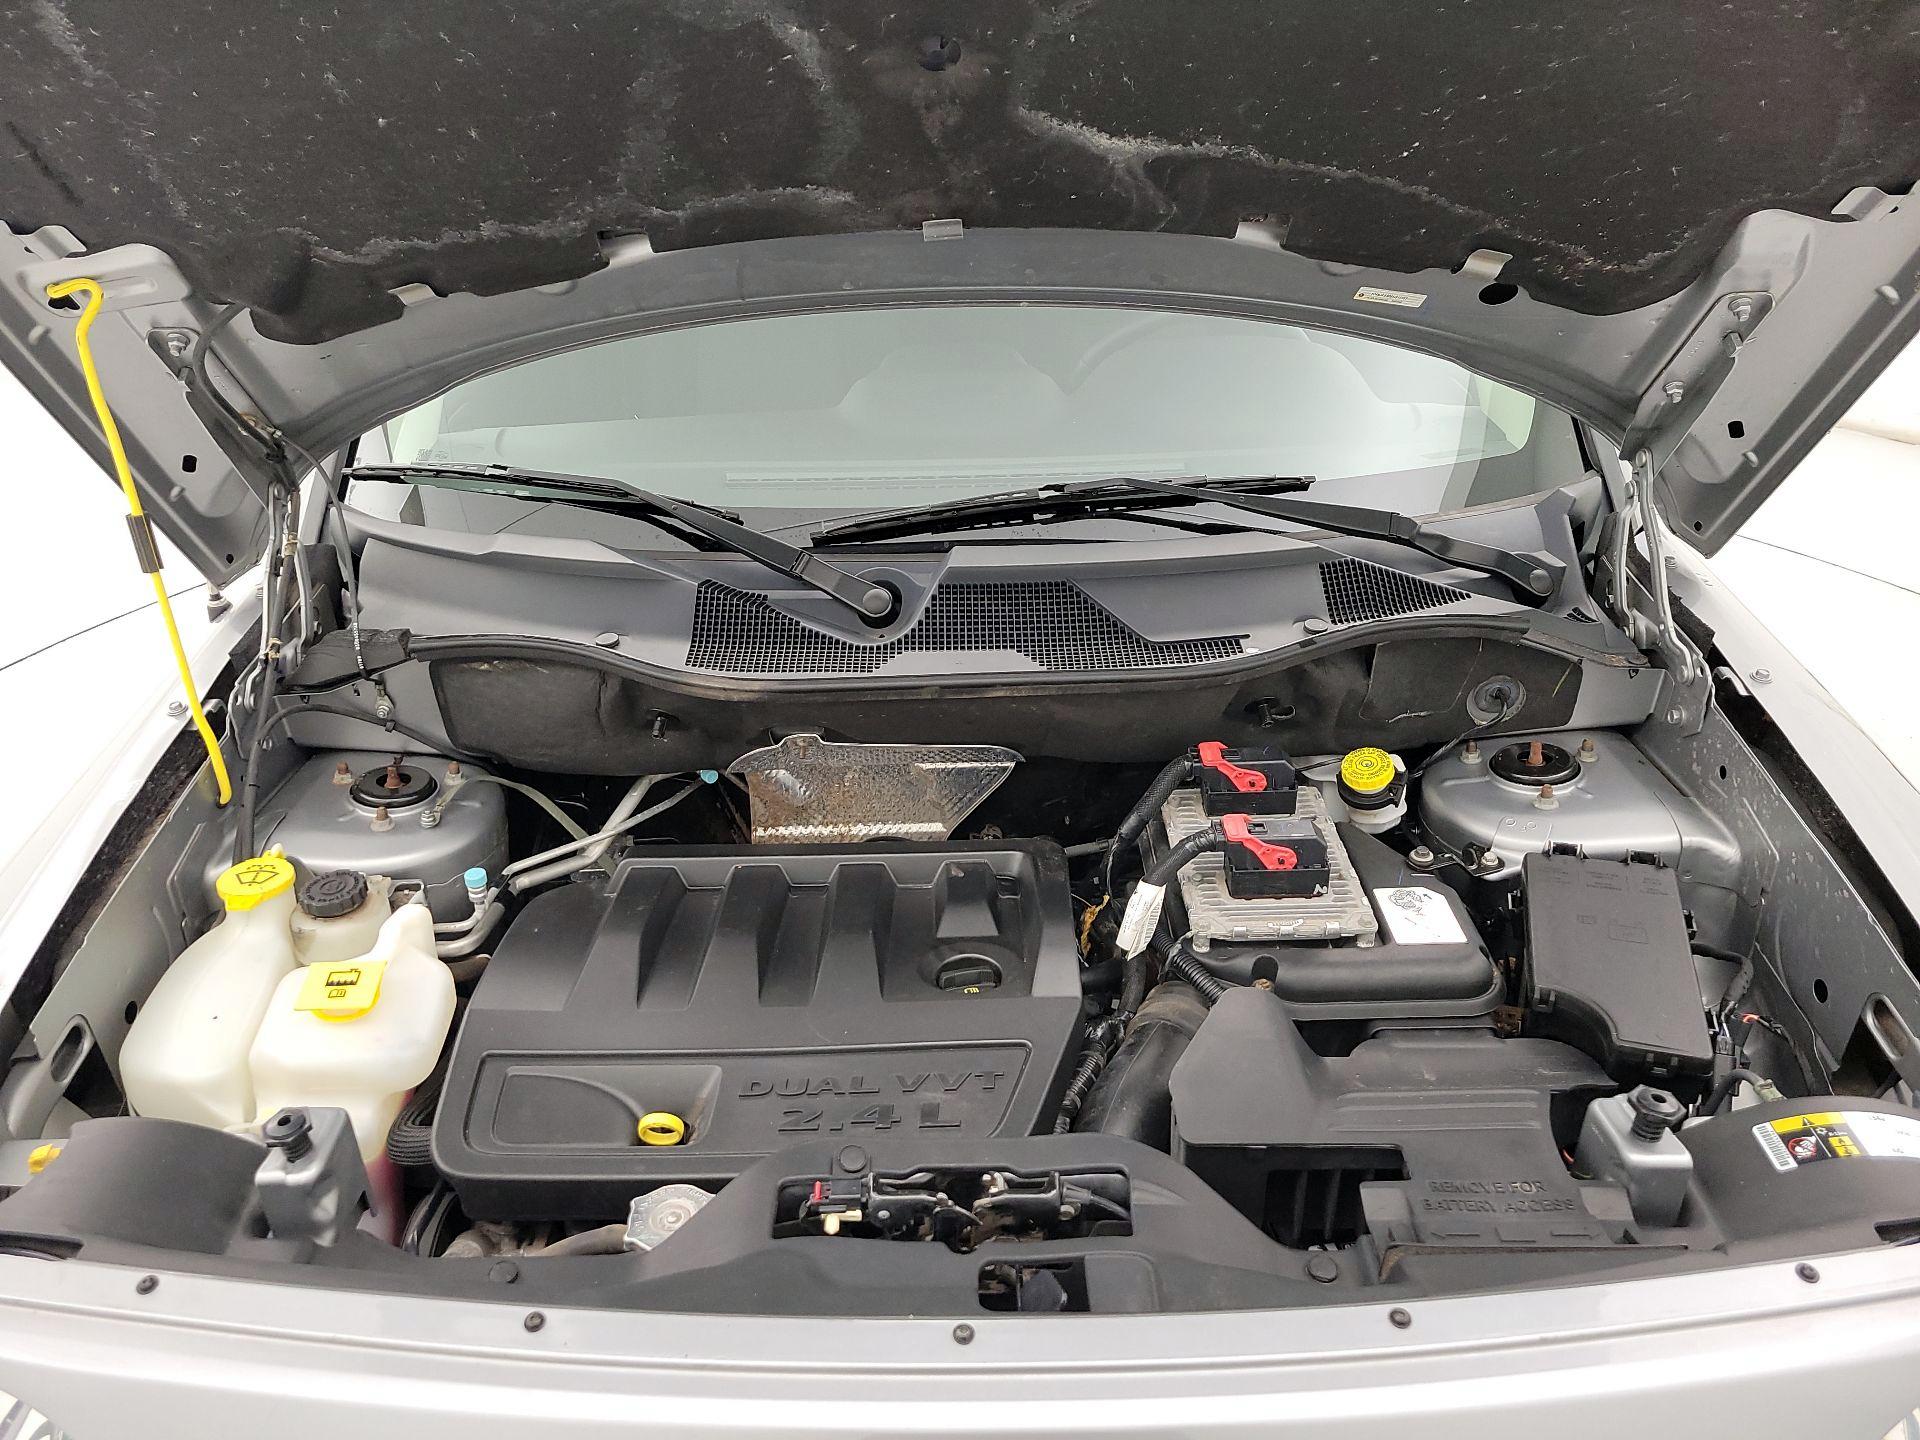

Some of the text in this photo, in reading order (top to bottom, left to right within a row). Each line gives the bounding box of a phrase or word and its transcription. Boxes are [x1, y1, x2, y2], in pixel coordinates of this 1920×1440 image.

[738, 1072, 1005, 1097] DUAL VVT
[1428, 1180, 1547, 1194] REMOVE FOR
[1422, 1198, 1577, 1213] BATTERY ACCESS
